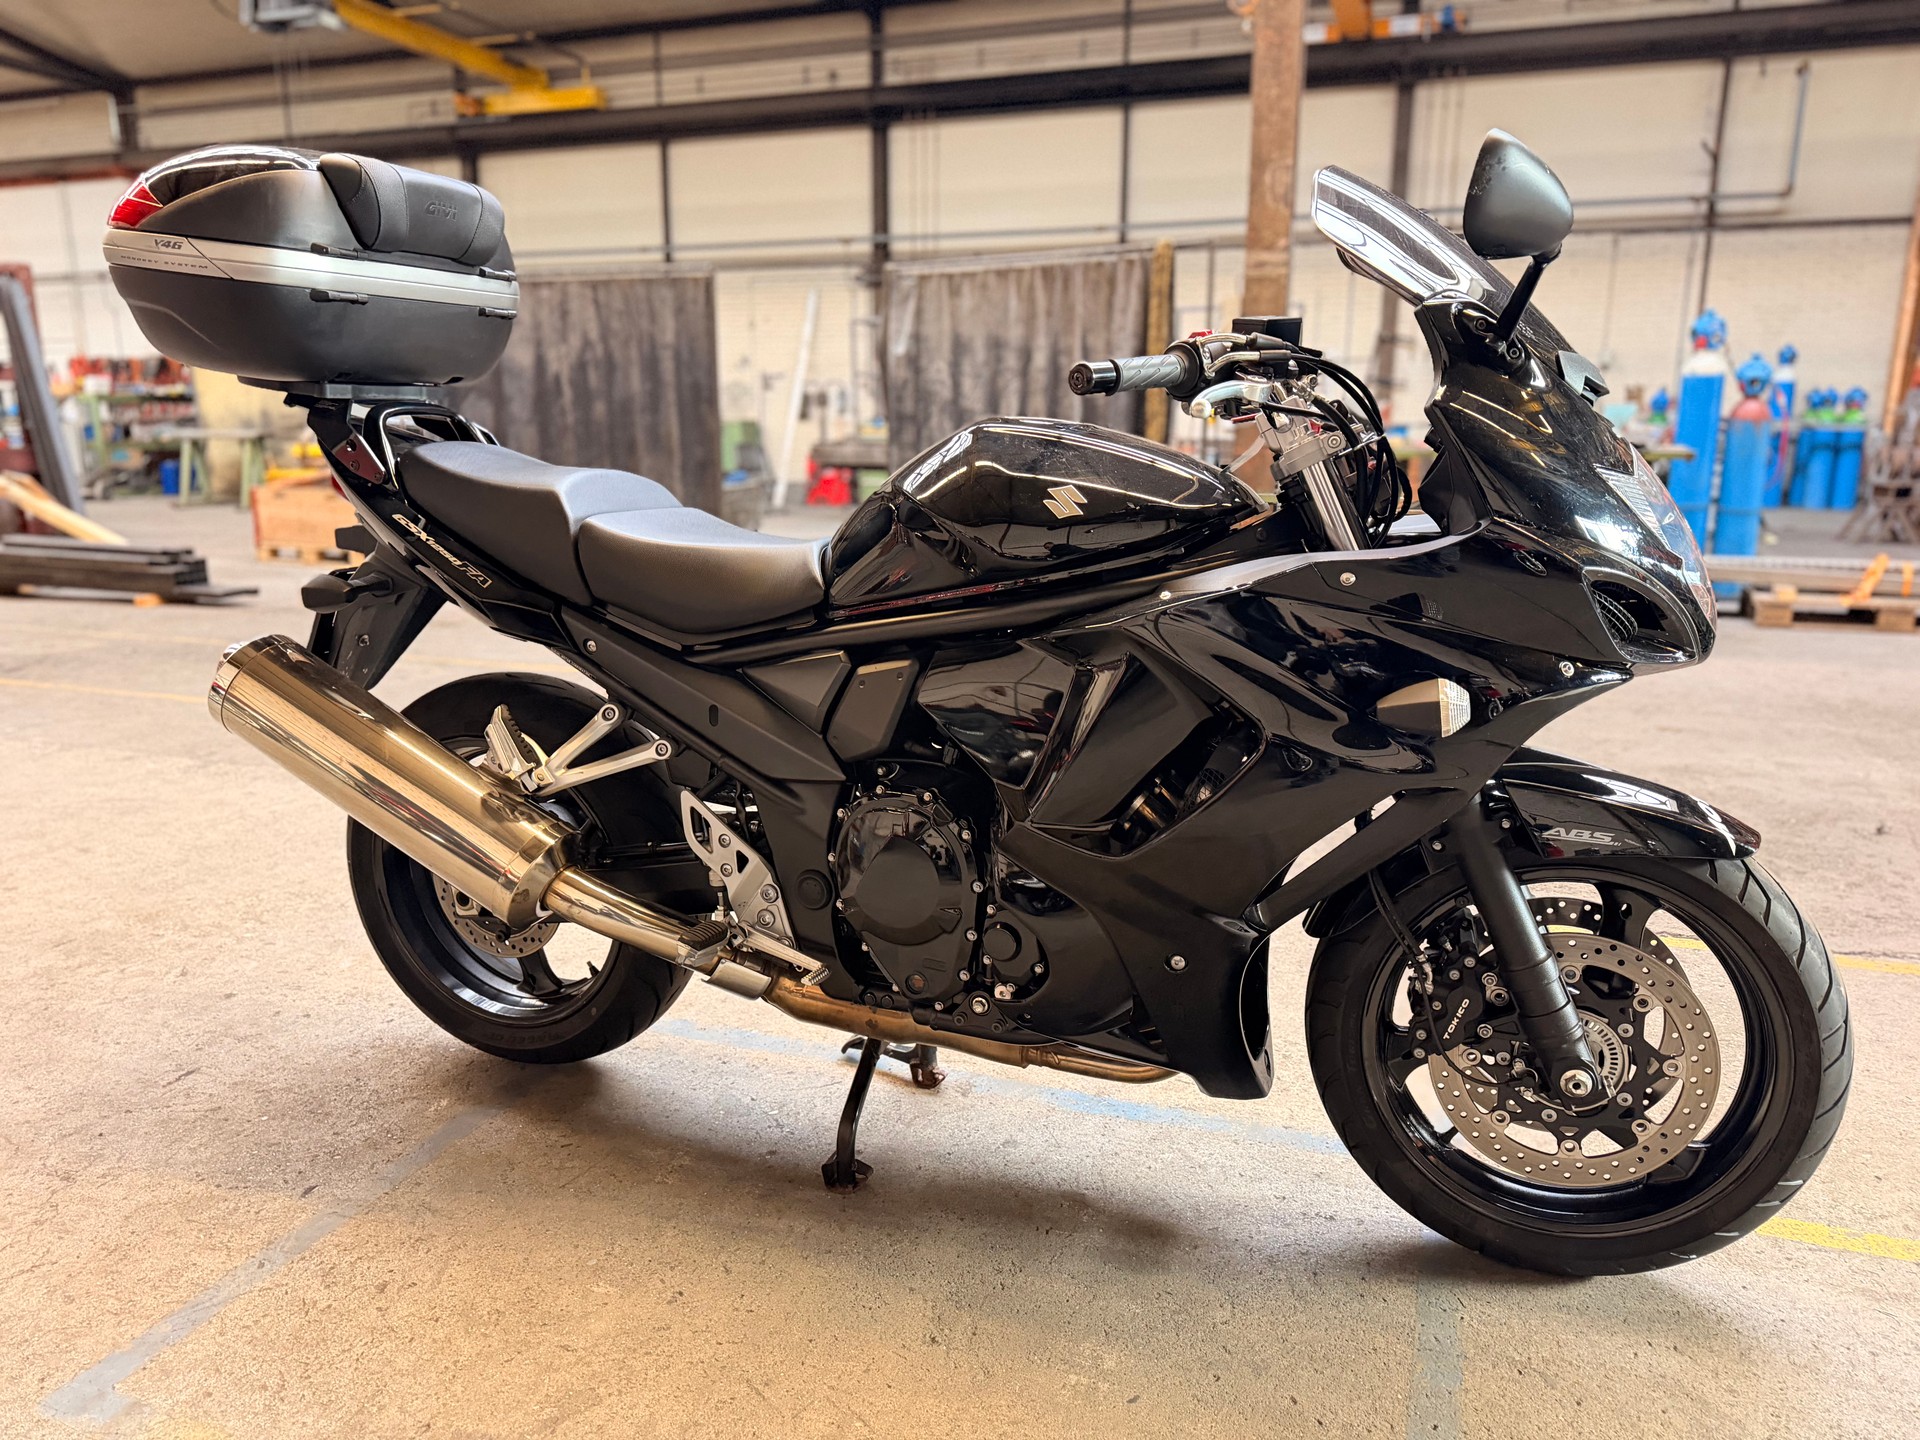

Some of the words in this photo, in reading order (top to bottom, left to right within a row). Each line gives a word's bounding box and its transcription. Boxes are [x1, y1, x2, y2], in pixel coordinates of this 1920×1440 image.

[424, 200, 457, 221] GIVI
[164, 261, 209, 269] SYSTEM
[1541, 827, 1616, 843] ABS
[1442, 998, 1470, 1040] TOKICO
